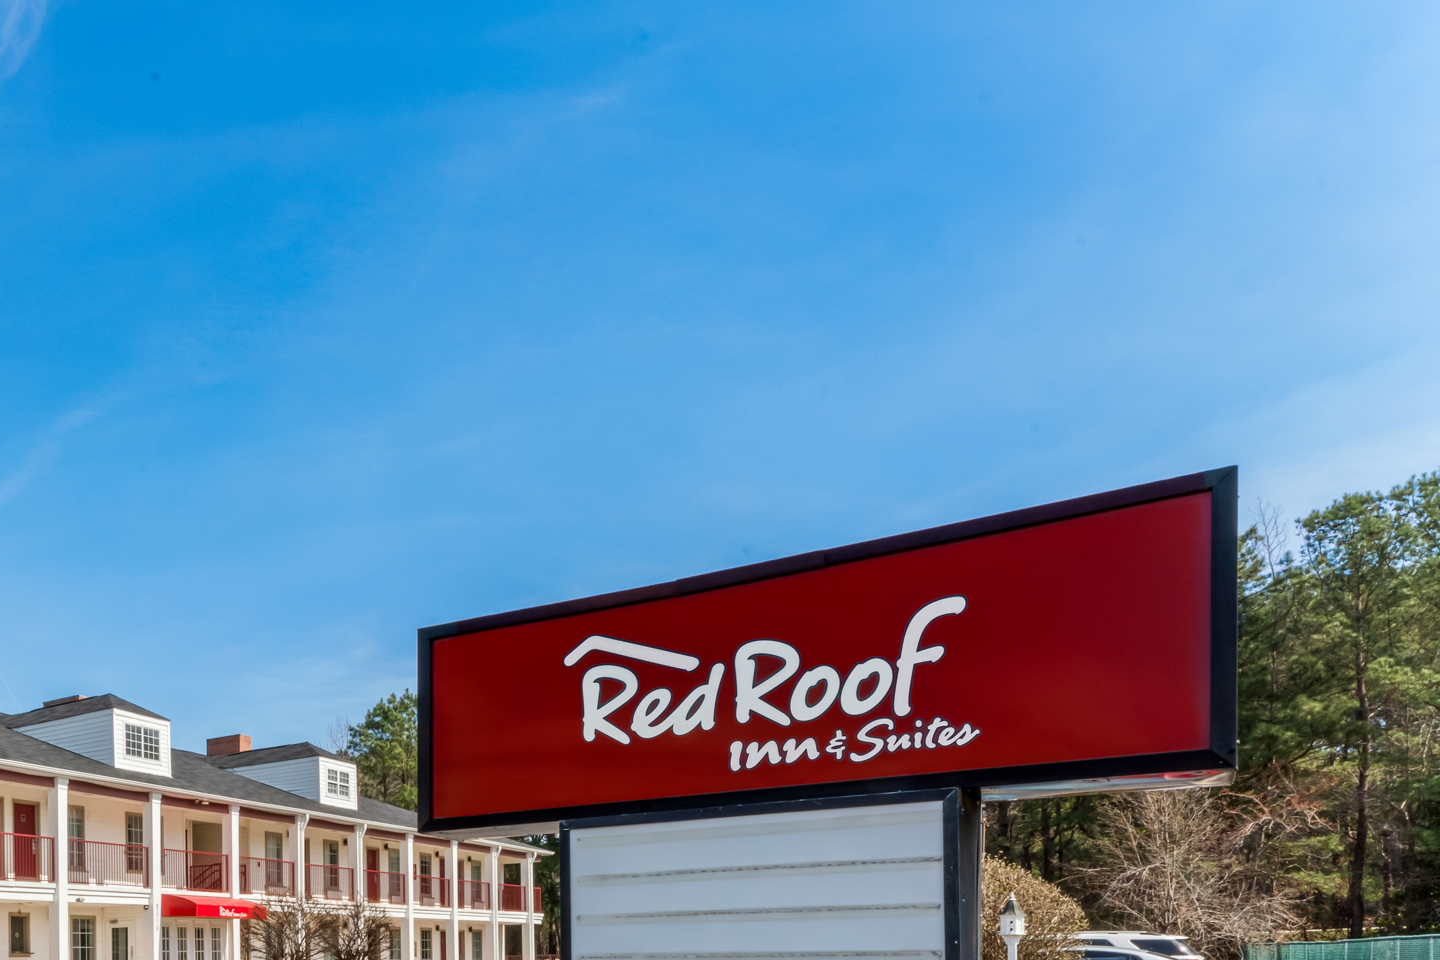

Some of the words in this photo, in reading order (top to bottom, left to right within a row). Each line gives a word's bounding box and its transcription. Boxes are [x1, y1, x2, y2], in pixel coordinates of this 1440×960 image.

[582, 664, 726, 745] Red
[734, 594, 968, 727] Roof
[728, 736, 821, 773] Inn
[825, 729, 848, 761] &
[849, 716, 982, 763] Suites
